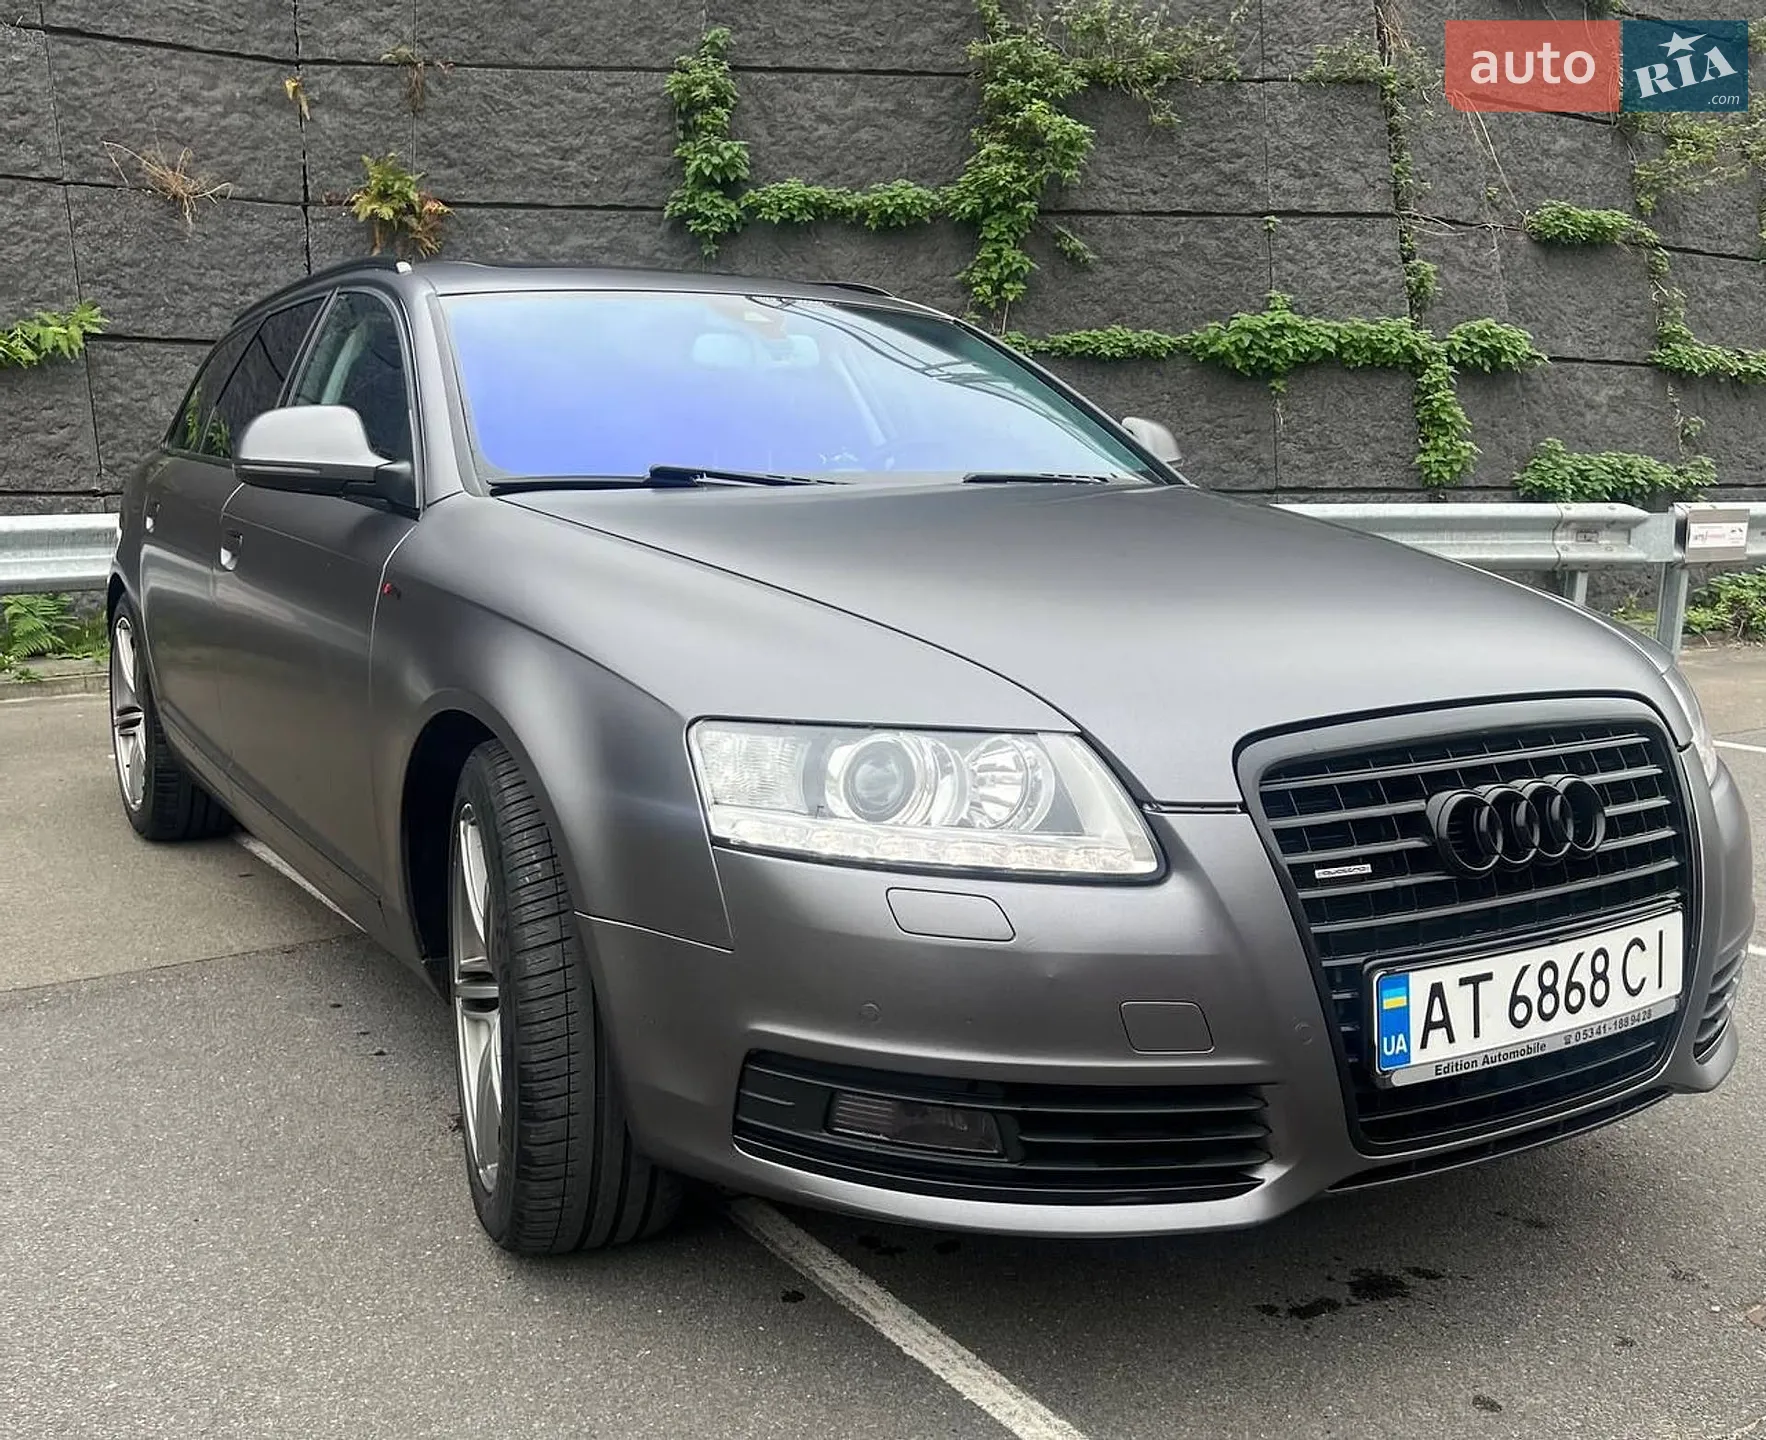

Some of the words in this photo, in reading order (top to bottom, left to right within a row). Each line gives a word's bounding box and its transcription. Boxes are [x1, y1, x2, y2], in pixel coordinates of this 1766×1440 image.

[1420, 971, 1494, 1050] AT
[1508, 947, 1611, 1029] 6868
[1622, 929, 1665, 998] CI
[1383, 1034, 1408, 1056] UA
[1434, 1055, 1479, 1077] Edition
[1481, 1041, 1547, 1066] Automobile
